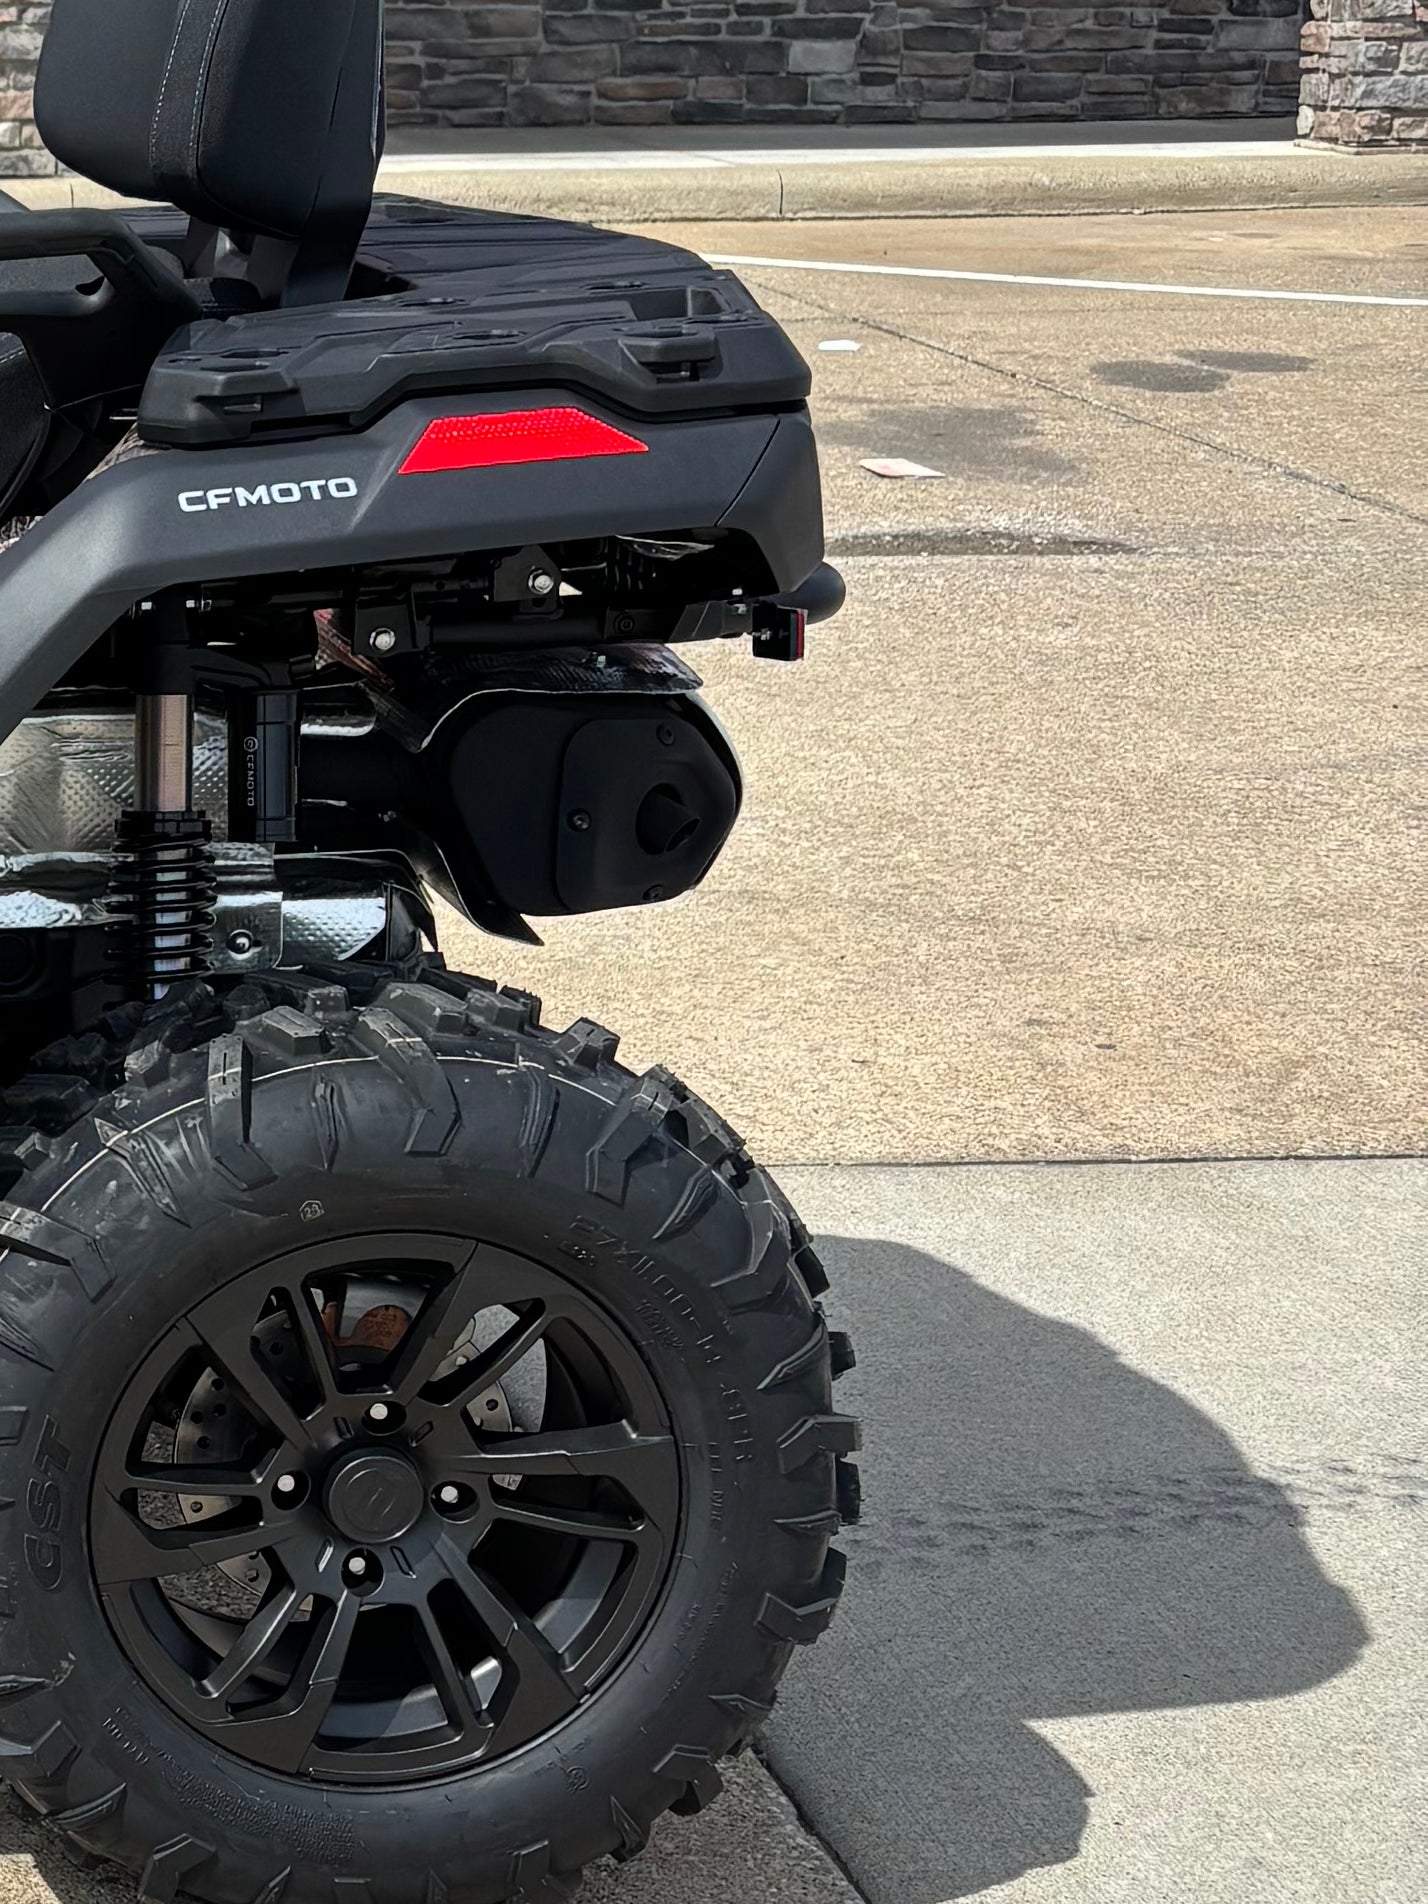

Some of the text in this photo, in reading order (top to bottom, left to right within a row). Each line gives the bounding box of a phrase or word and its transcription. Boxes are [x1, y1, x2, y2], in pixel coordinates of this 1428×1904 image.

[178, 477, 358, 512] CFMOTO
[246, 754, 255, 807] CFMOTO
[24, 1413, 72, 1590] CST
